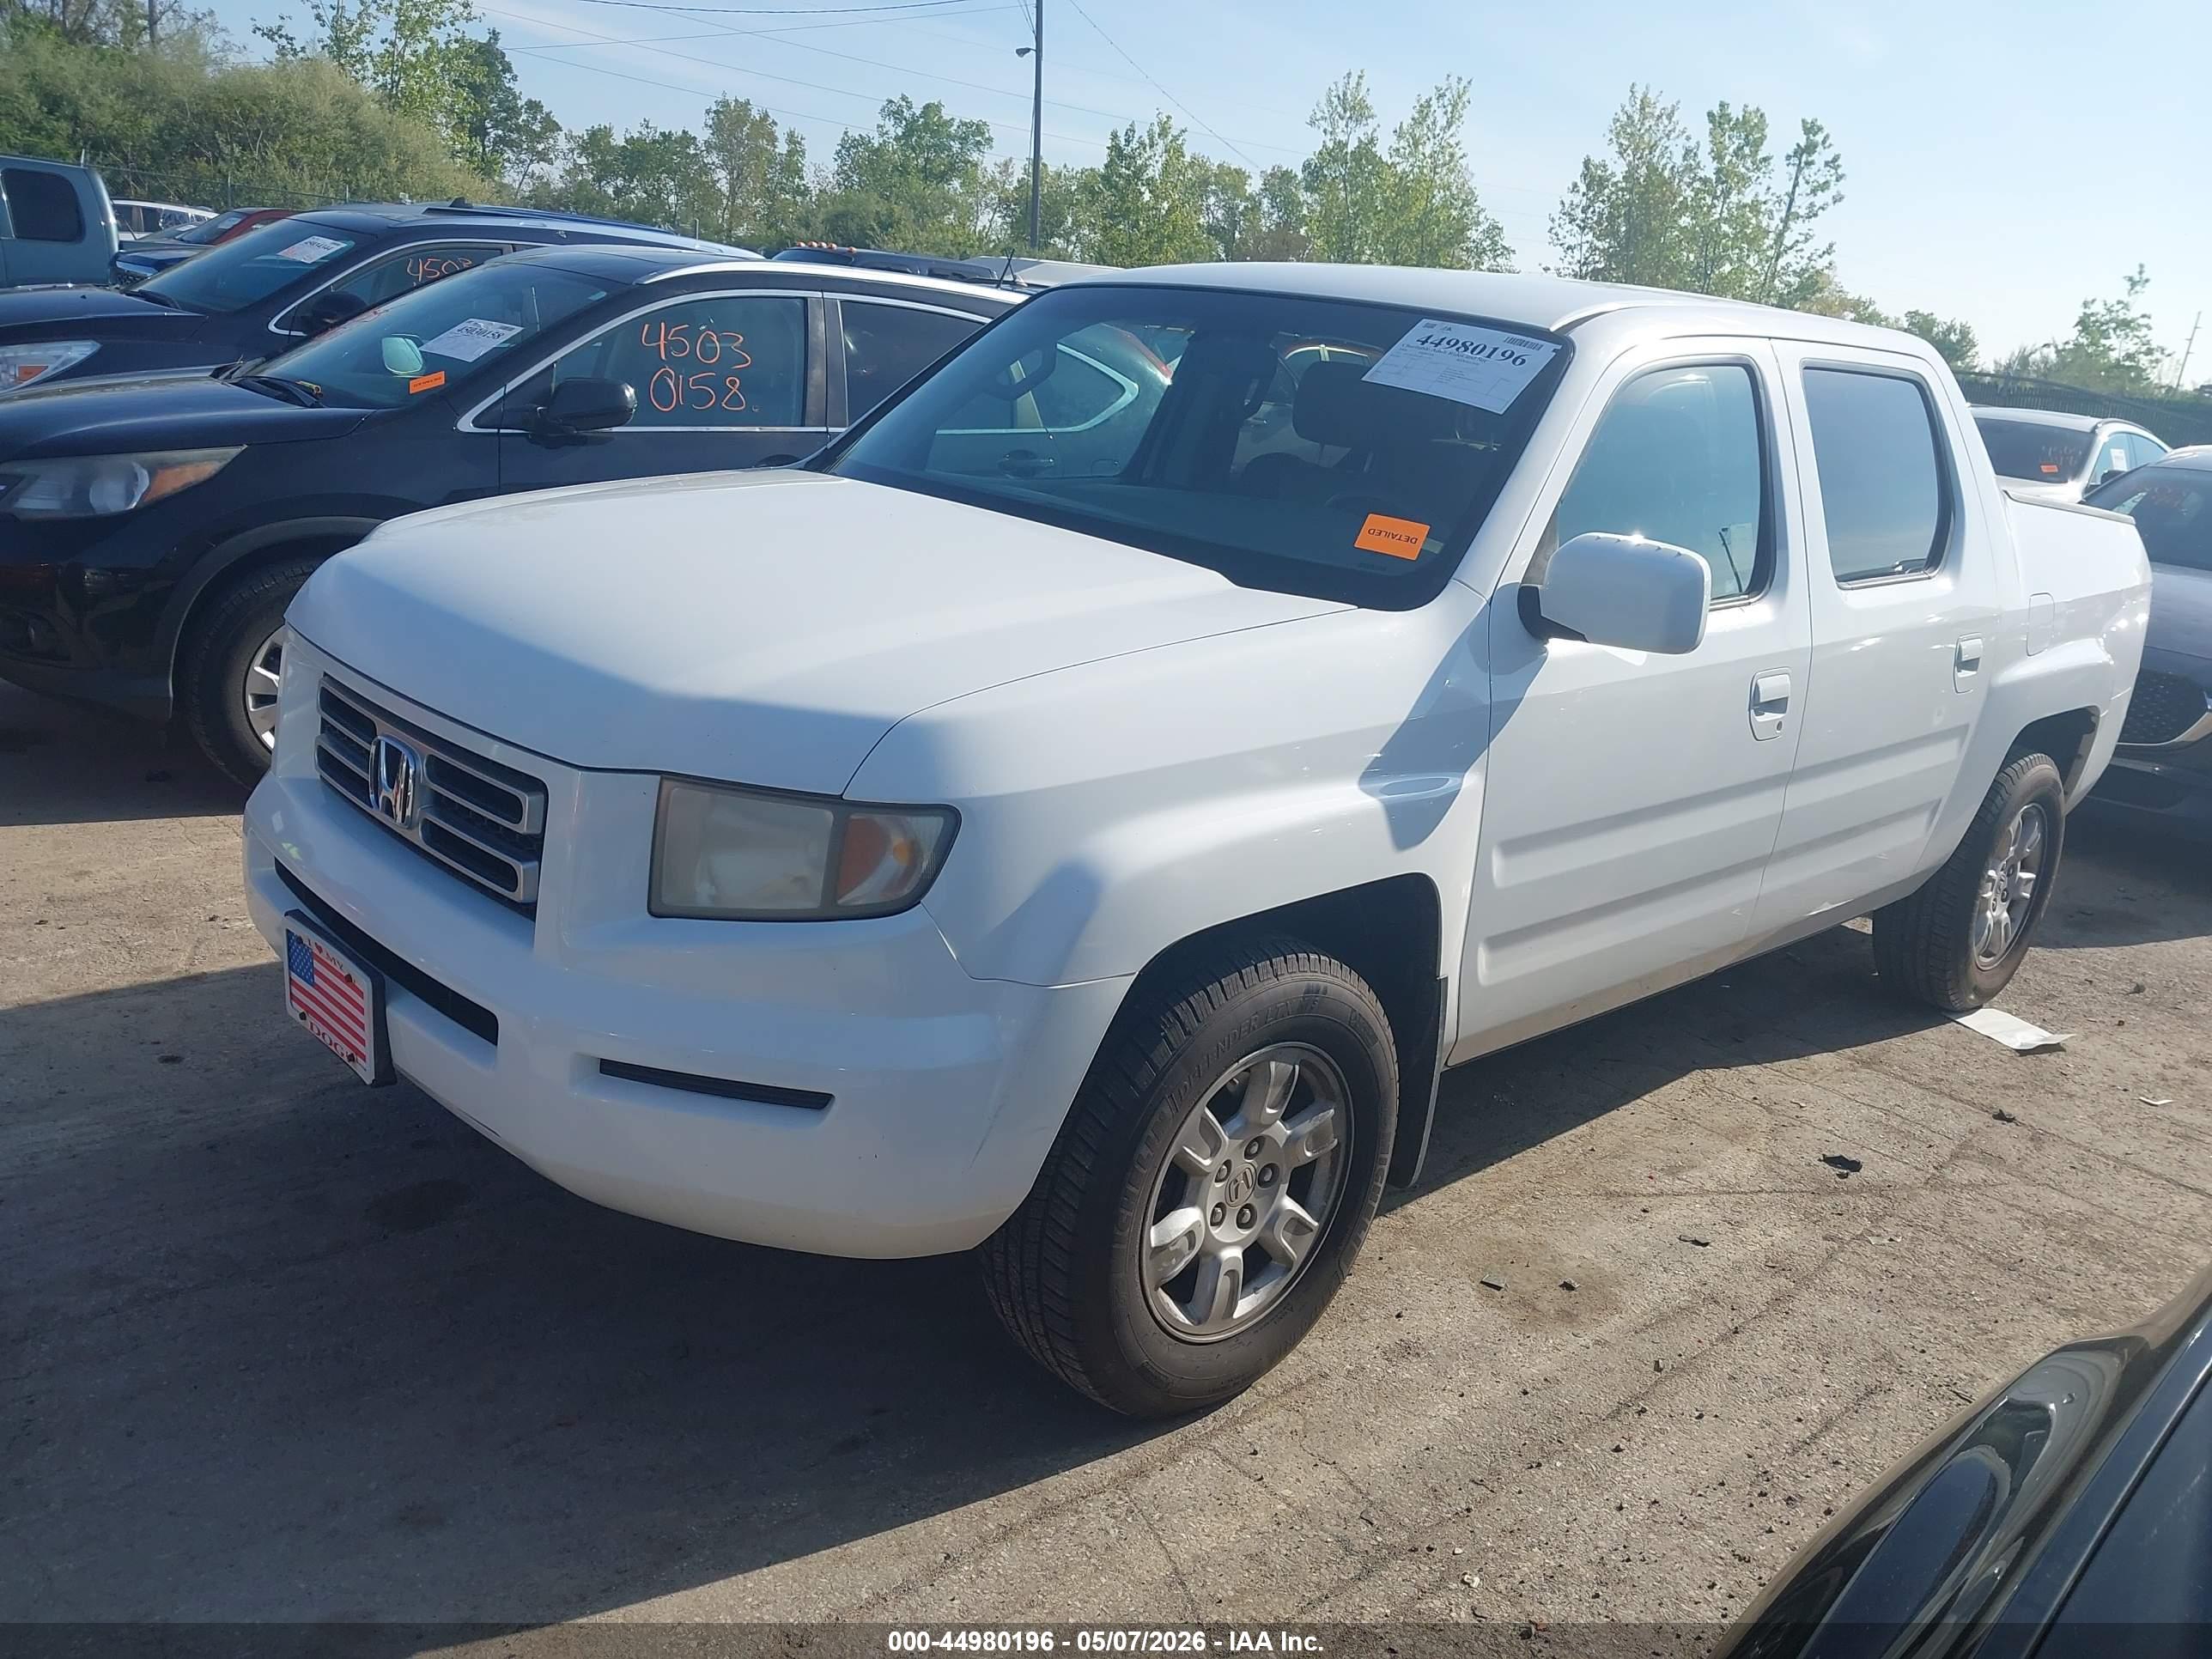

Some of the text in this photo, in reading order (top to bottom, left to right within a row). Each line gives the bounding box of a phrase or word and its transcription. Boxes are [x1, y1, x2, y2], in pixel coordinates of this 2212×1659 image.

[641, 321, 752, 369] 4503
[1415, 333, 1533, 368] 44980196
[1367, 527, 1419, 545] DETAILED
